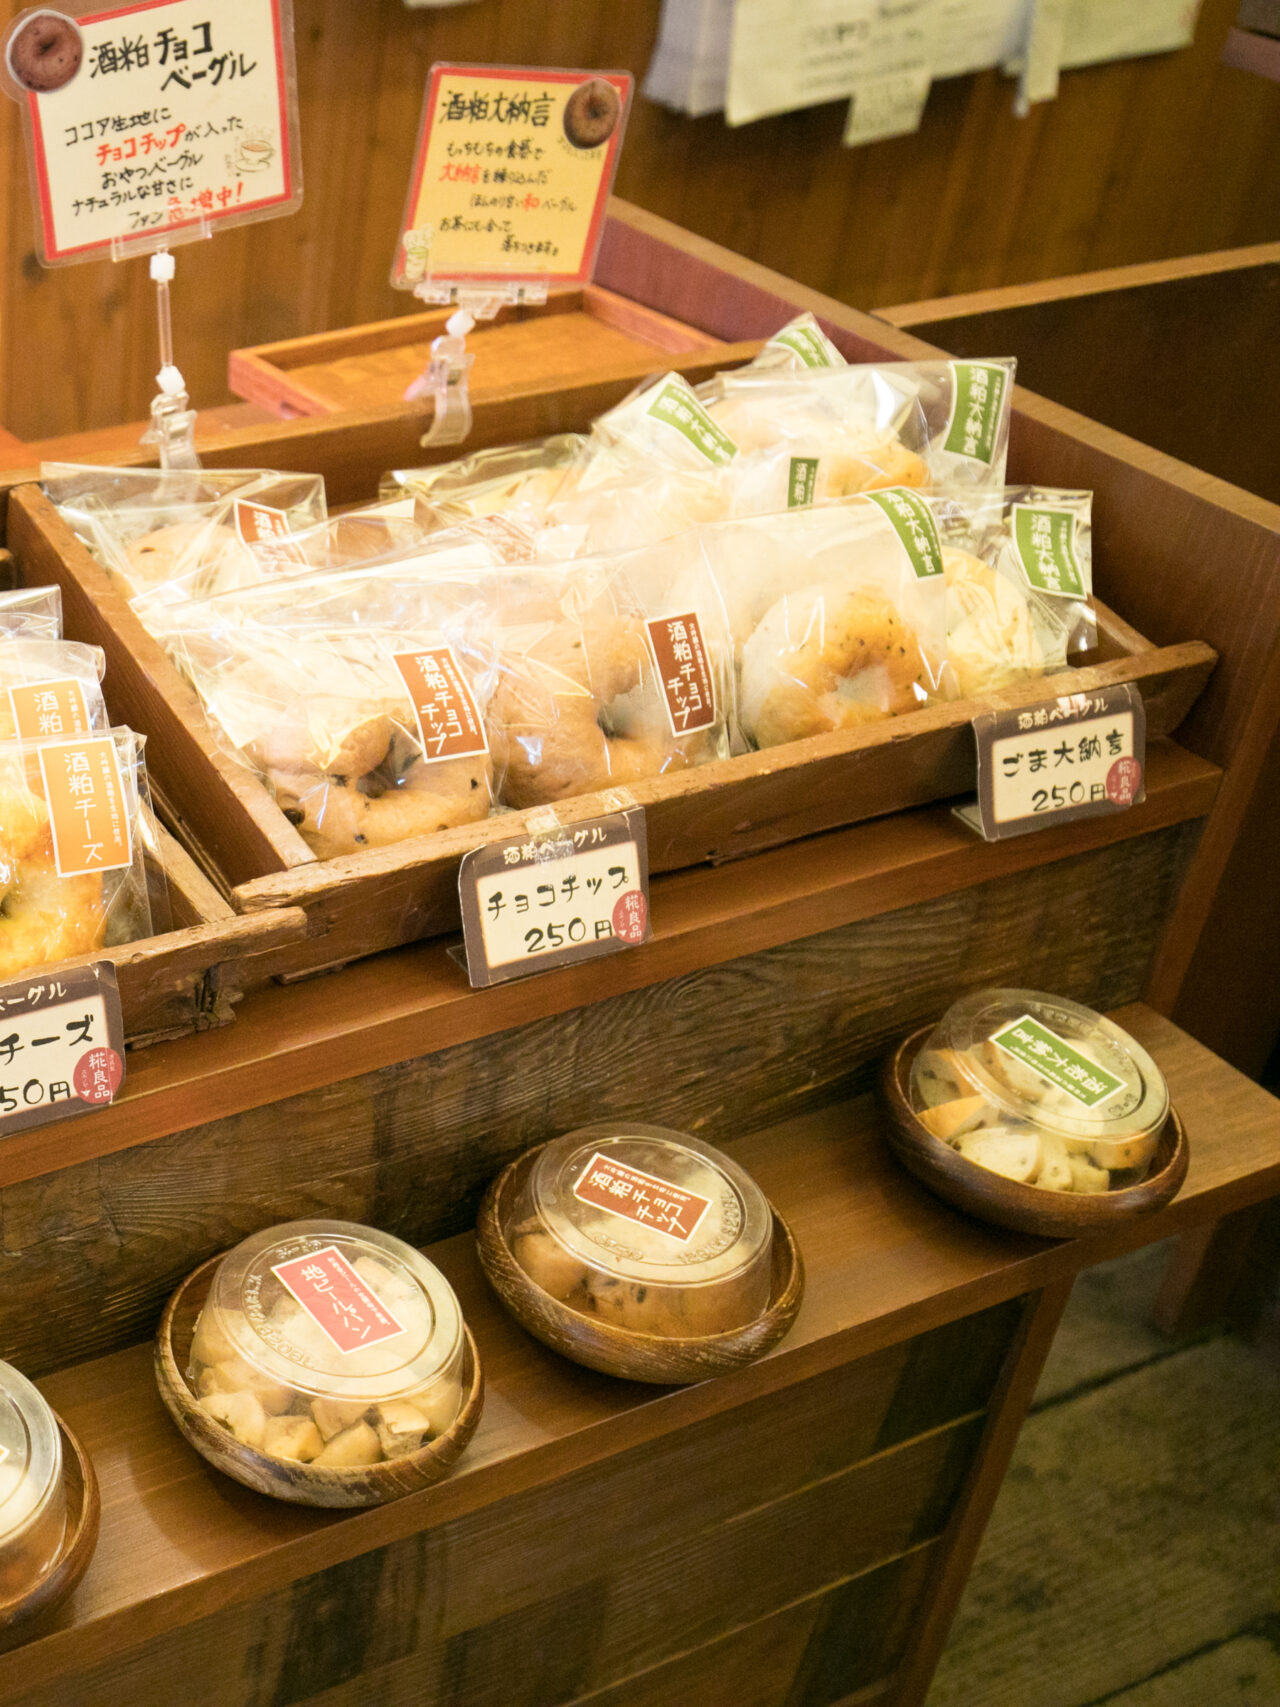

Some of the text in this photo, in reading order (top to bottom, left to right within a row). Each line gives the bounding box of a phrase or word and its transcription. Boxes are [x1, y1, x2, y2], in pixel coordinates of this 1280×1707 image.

[90, 22, 213, 78] 酒粕チョコ
[161, 51, 257, 91] ベーグル
[65, 108, 172, 147] ココア生地に
[439, 90, 555, 126] 酒粕大納言
[96, 116, 244, 166] チョコチップが入った
[102, 149, 204, 190] おやつベーグル
[72, 175, 194, 216] ナチュラルな甘さに
[667, 621, 702, 712] 酒粕チョコ
[415, 655, 463, 737] 酒粕チョコ
[667, 677, 690, 728] チップ
[421, 703, 447, 754] チップ
[1002, 728, 1124, 777] ごま大納言
[64, 751, 104, 864] 酒粕チーズ
[1031, 781, 1106, 812] 250円
[487, 866, 629, 921] チョコチップ
[524, 917, 613, 953] 250円
[89, 1051, 110, 1099] 糀良品
[301, 1264, 371, 1339] 地ビールパン
